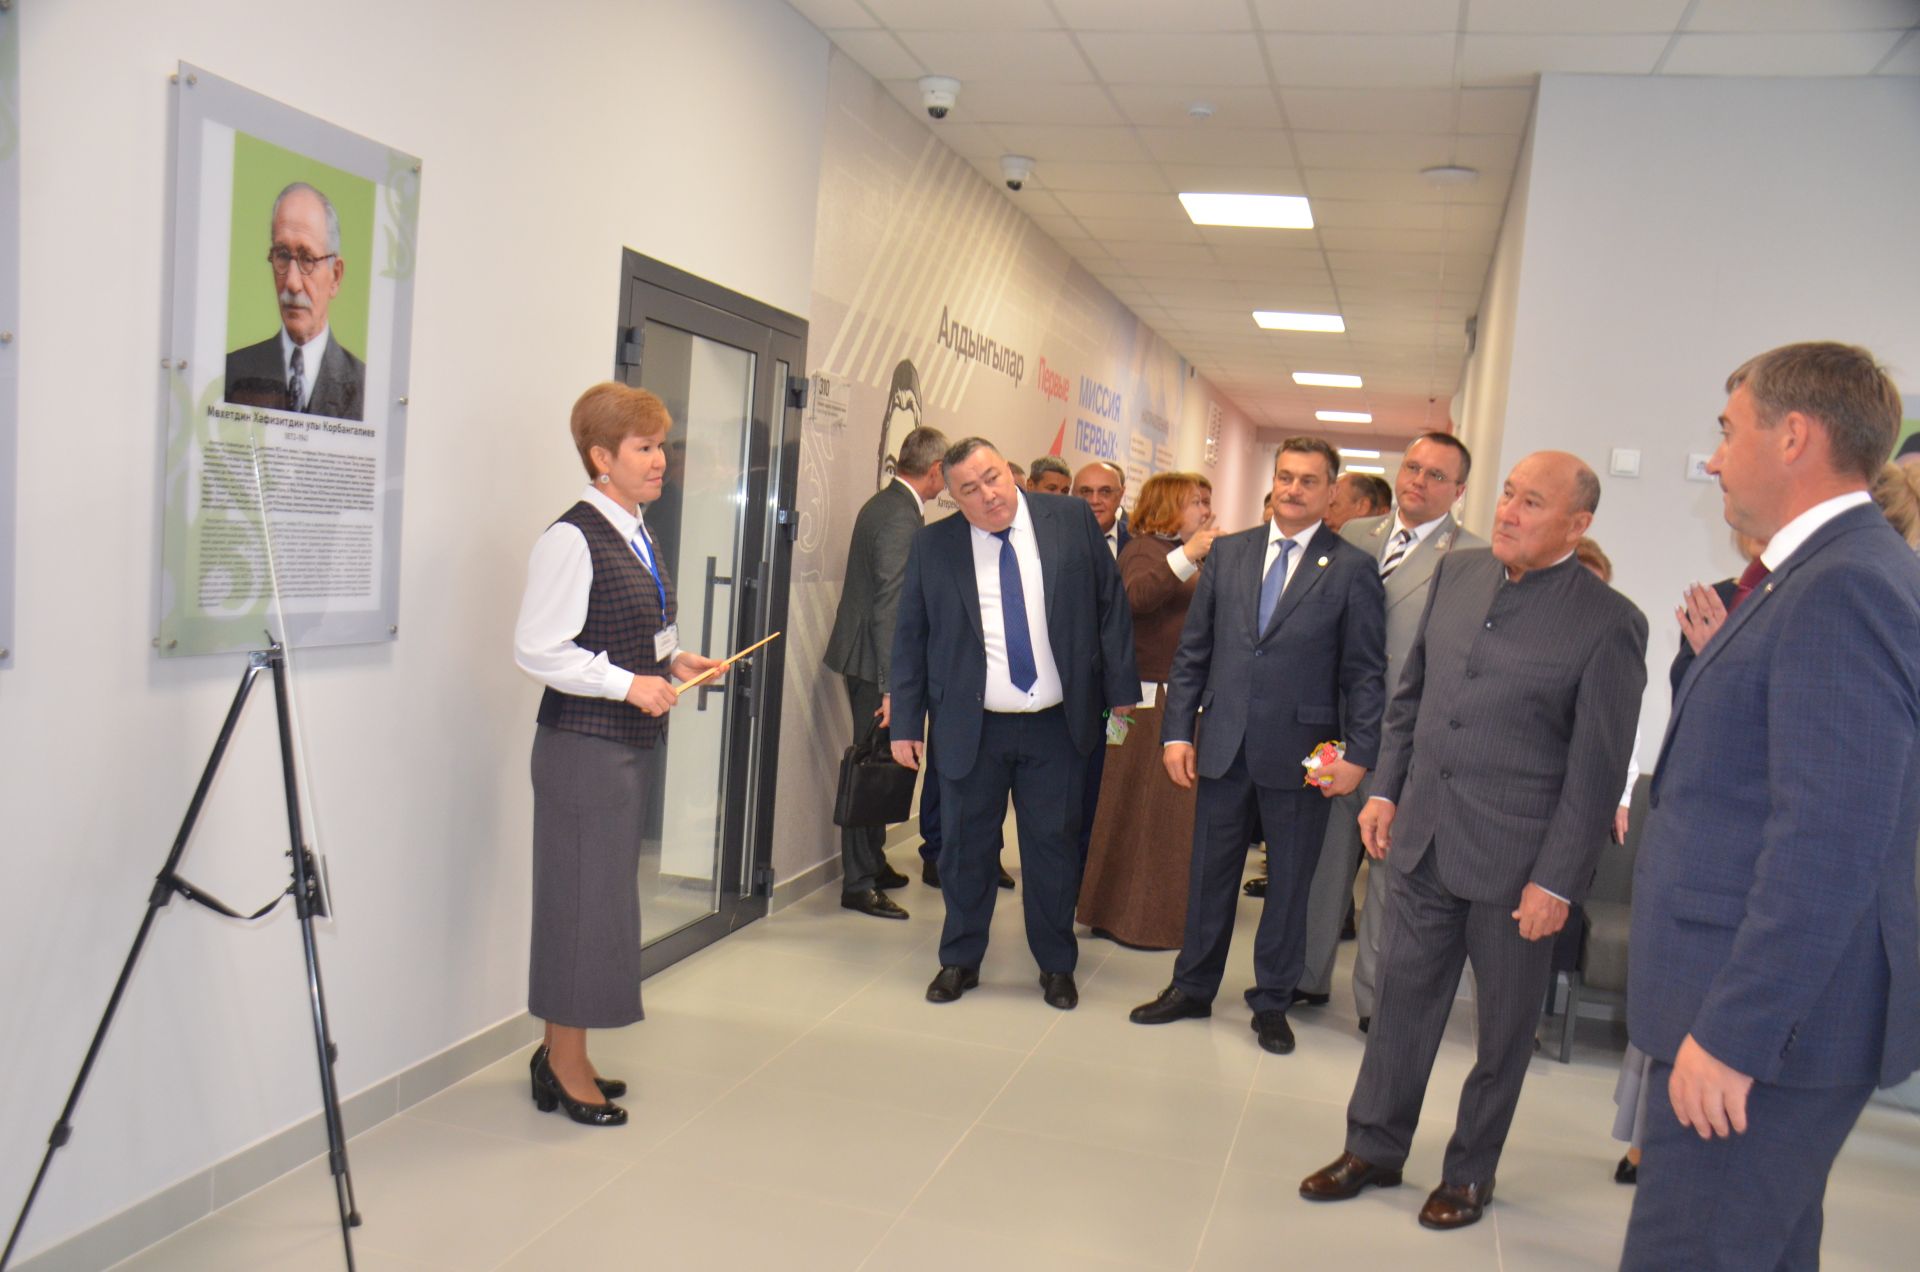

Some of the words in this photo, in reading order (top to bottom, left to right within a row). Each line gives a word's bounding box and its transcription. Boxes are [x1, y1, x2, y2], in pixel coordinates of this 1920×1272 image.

[937, 304, 1024, 389] Алдынгылар
[819, 377, 830, 397] 310
[1038, 355, 1070, 402] Первые
[1079, 375, 1121, 422] МИССИЯ
[306, 421, 321, 432] улы
[1075, 418, 1118, 461] ПЕРВЫХ:
